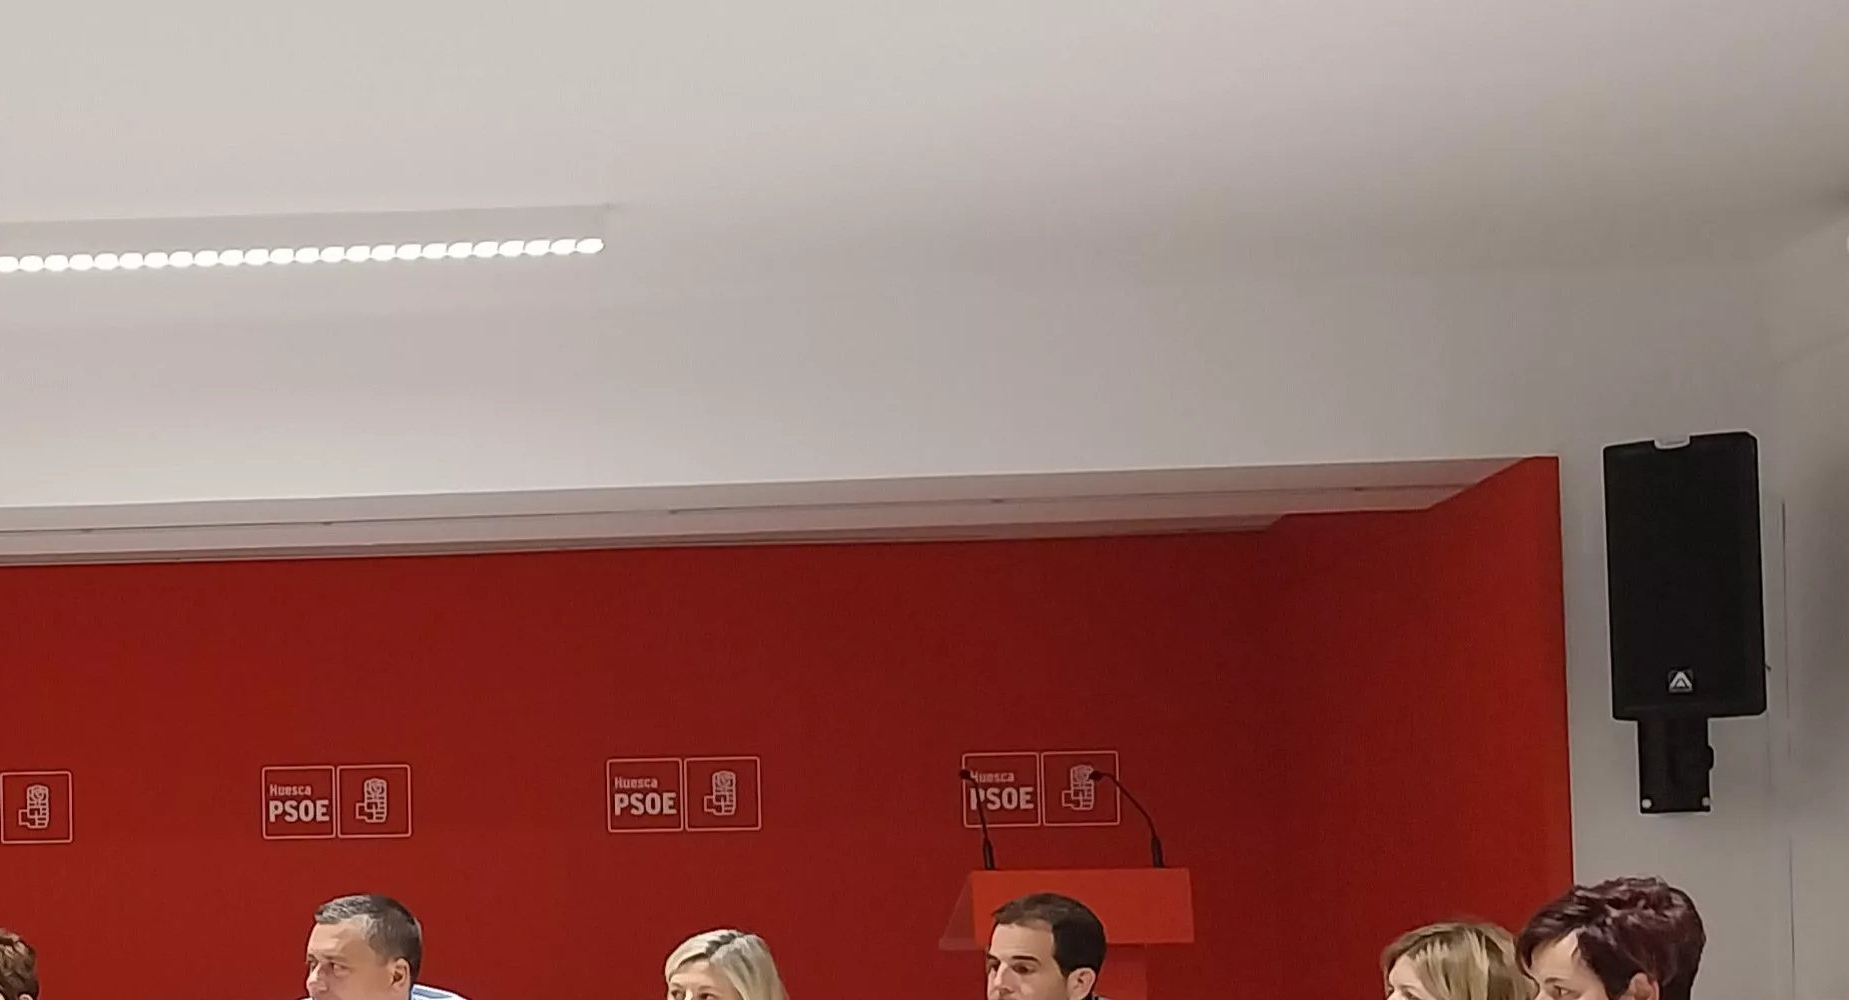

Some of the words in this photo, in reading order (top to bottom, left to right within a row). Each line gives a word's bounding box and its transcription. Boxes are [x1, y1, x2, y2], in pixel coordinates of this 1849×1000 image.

[269, 784, 312, 797] Huesca
[614, 776, 659, 789] Huesca
[614, 792, 678, 816] PSOE
[969, 786, 1035, 810] PSOE
[269, 799, 330, 823] PSOE
